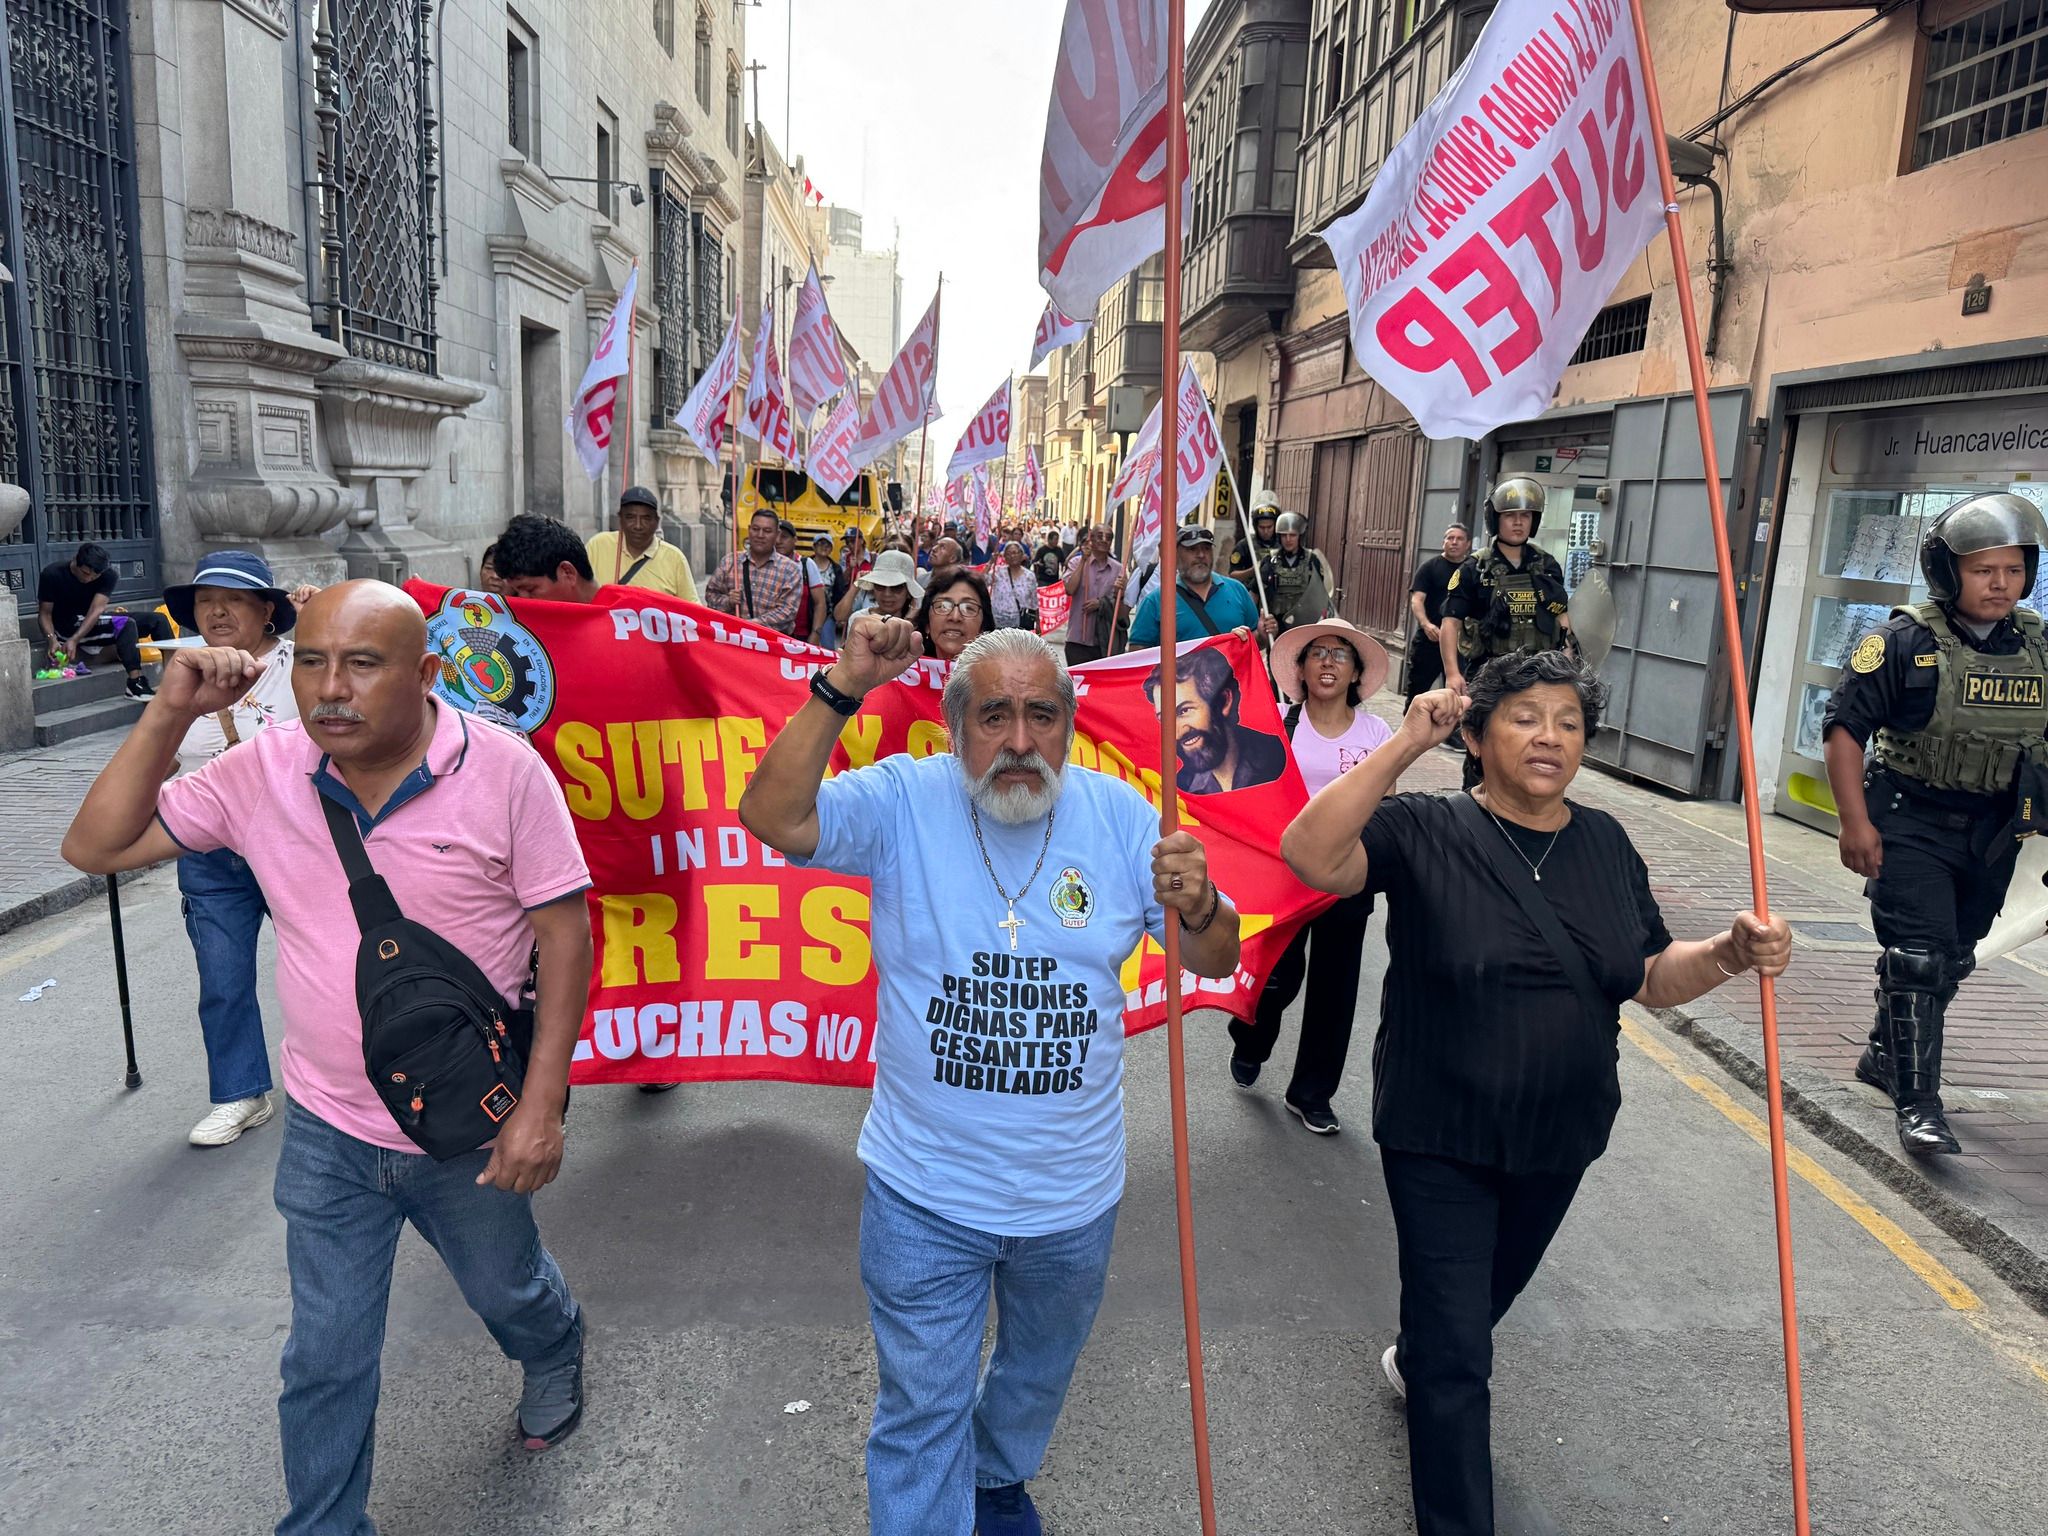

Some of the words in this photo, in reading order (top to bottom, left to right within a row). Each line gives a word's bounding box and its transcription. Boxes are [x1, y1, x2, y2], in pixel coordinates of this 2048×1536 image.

[1967, 292, 1985, 308] 126
[1884, 436, 1899, 456] Jr.
[1913, 422, 2048, 455] Huancavelica
[608, 607, 700, 643] POR
[1509, 603, 1536, 614] POLICI
[1967, 677, 2041, 703] POLICIA
[554, 716, 835, 821] SUTE
[651, 826, 786, 875] INDE
[597, 883, 873, 989] RES
[971, 951, 1058, 981] SUTEP
[942, 973, 1088, 1010] PENSIONES
[925, 996, 1028, 1039] DIGNAS
[1035, 1009, 1098, 1039] PARA
[815, 1012, 862, 1063] NO
[930, 1028, 1072, 1068] CESANTES
[1077, 1037, 1090, 1064] Y
[933, 1057, 1084, 1095] JUBILADOS
